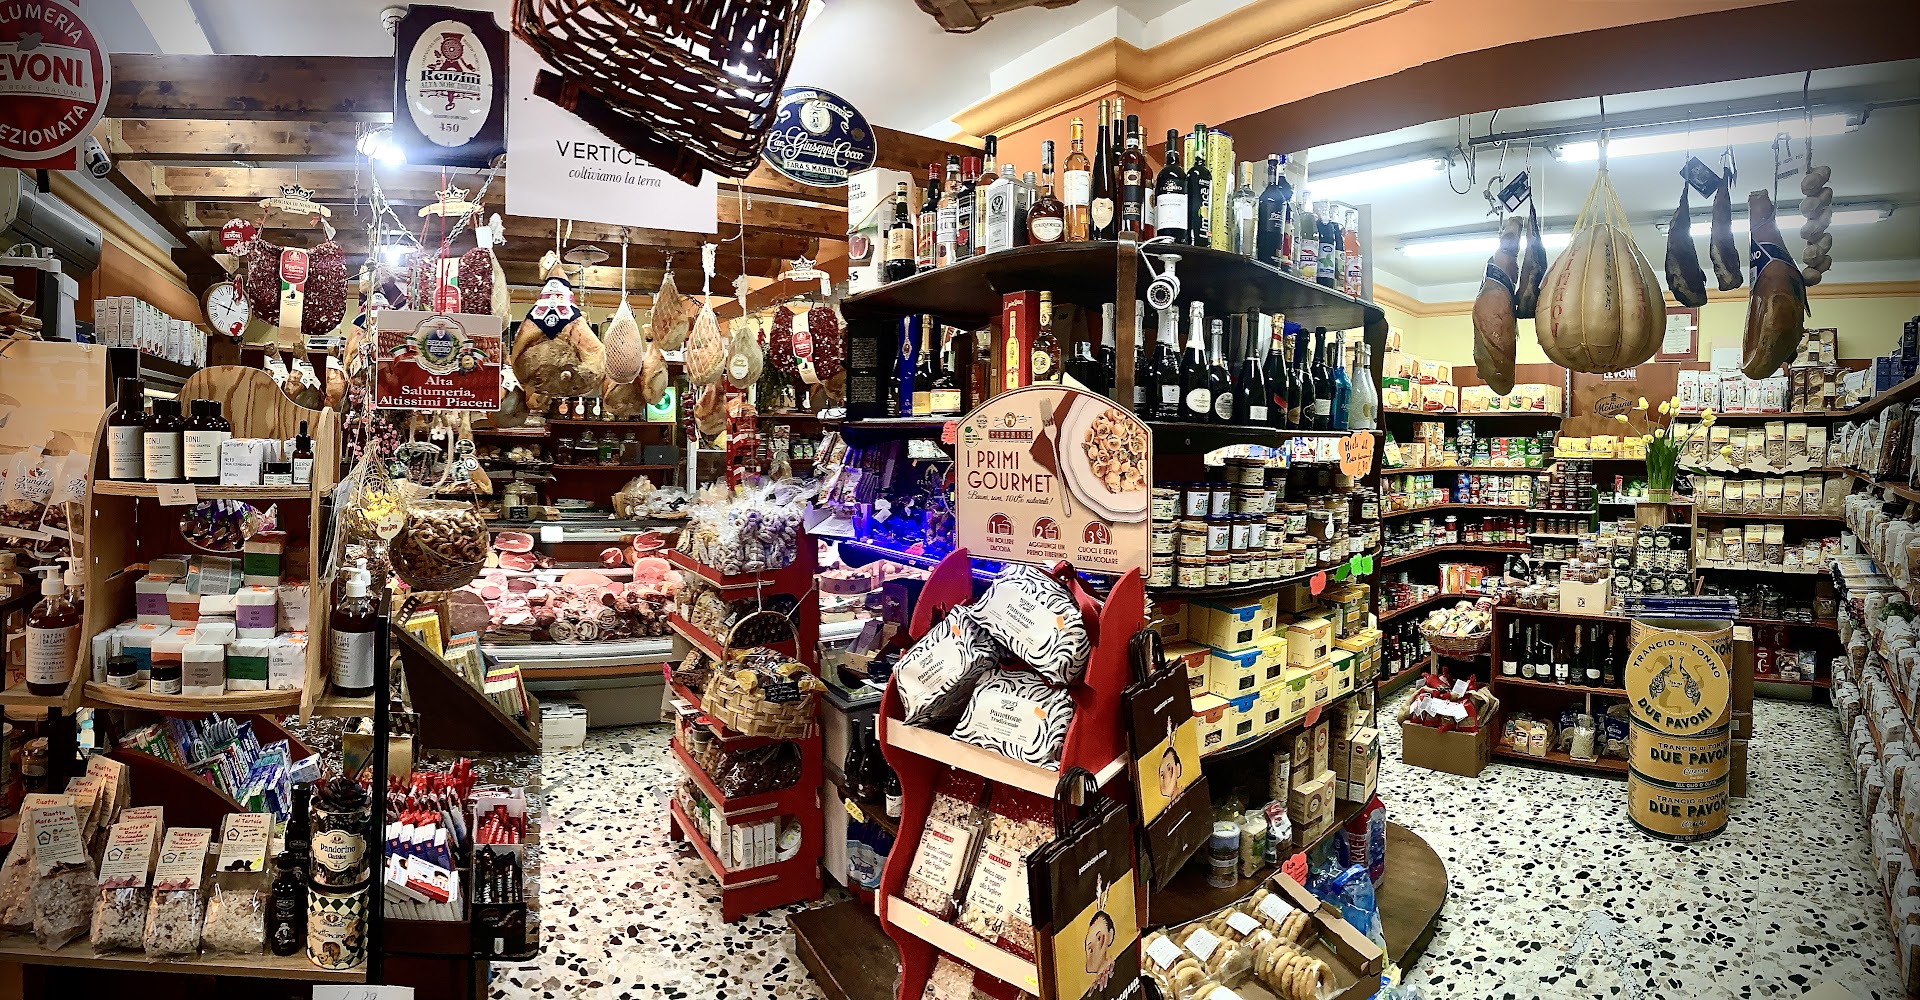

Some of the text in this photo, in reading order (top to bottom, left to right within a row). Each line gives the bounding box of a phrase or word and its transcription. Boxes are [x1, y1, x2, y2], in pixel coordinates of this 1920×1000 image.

[556, 139, 656, 168] VERTICE
[782, 126, 837, 160] Giuseppe
[833, 138, 865, 168] Cocco
[786, 161, 804, 170] FARA
[811, 165, 845, 176] MARTINO
[568, 166, 662, 188] coltiviamo la terra
[425, 375, 454, 387] Alta
[401, 385, 476, 399] Salumeria,
[378, 395, 497, 408] Altissimi Piaceri.
[966, 450, 1019, 470] I PRIMI
[967, 470, 1053, 494] GOURMET
[1005, 494, 1025, 504] 100%
[991, 521, 996, 535] 1
[1036, 525, 1044, 539] 2
[1088, 530, 1095, 544] 3
[1026, 549, 1044, 557] PRIMO
[1077, 546, 1097, 554] CUOCI
[1102, 548, 1118, 556] SERVI
[1077, 554, 1119, 565] SENZA SCOLARE
[1006, 603, 1035, 627] Panettone
[1633, 639, 1676, 669] TRANCIO
[1691, 643, 1722, 679] TONNO
[917, 659, 945, 681] Panettone
[989, 708, 1023, 724] Panettone
[1637, 696, 1663, 724] DUE
[1665, 705, 1714, 730] PAVONI
[1658, 742, 1698, 752] TRANCIO
[1650, 746, 1730, 766] DUE PAVON
[86, 767, 118, 781] Mare Monti
[94, 763, 112, 773] Risotto
[82, 786, 97, 794] Monti
[35, 798, 58, 806] Risotto
[1656, 795, 1696, 804] TRANCIO
[42, 810, 66, 818] Risotto
[1649, 798, 1727, 818] DUE PAVON
[34, 816, 53, 825] Mare
[320, 842, 356, 854] Pandorino
